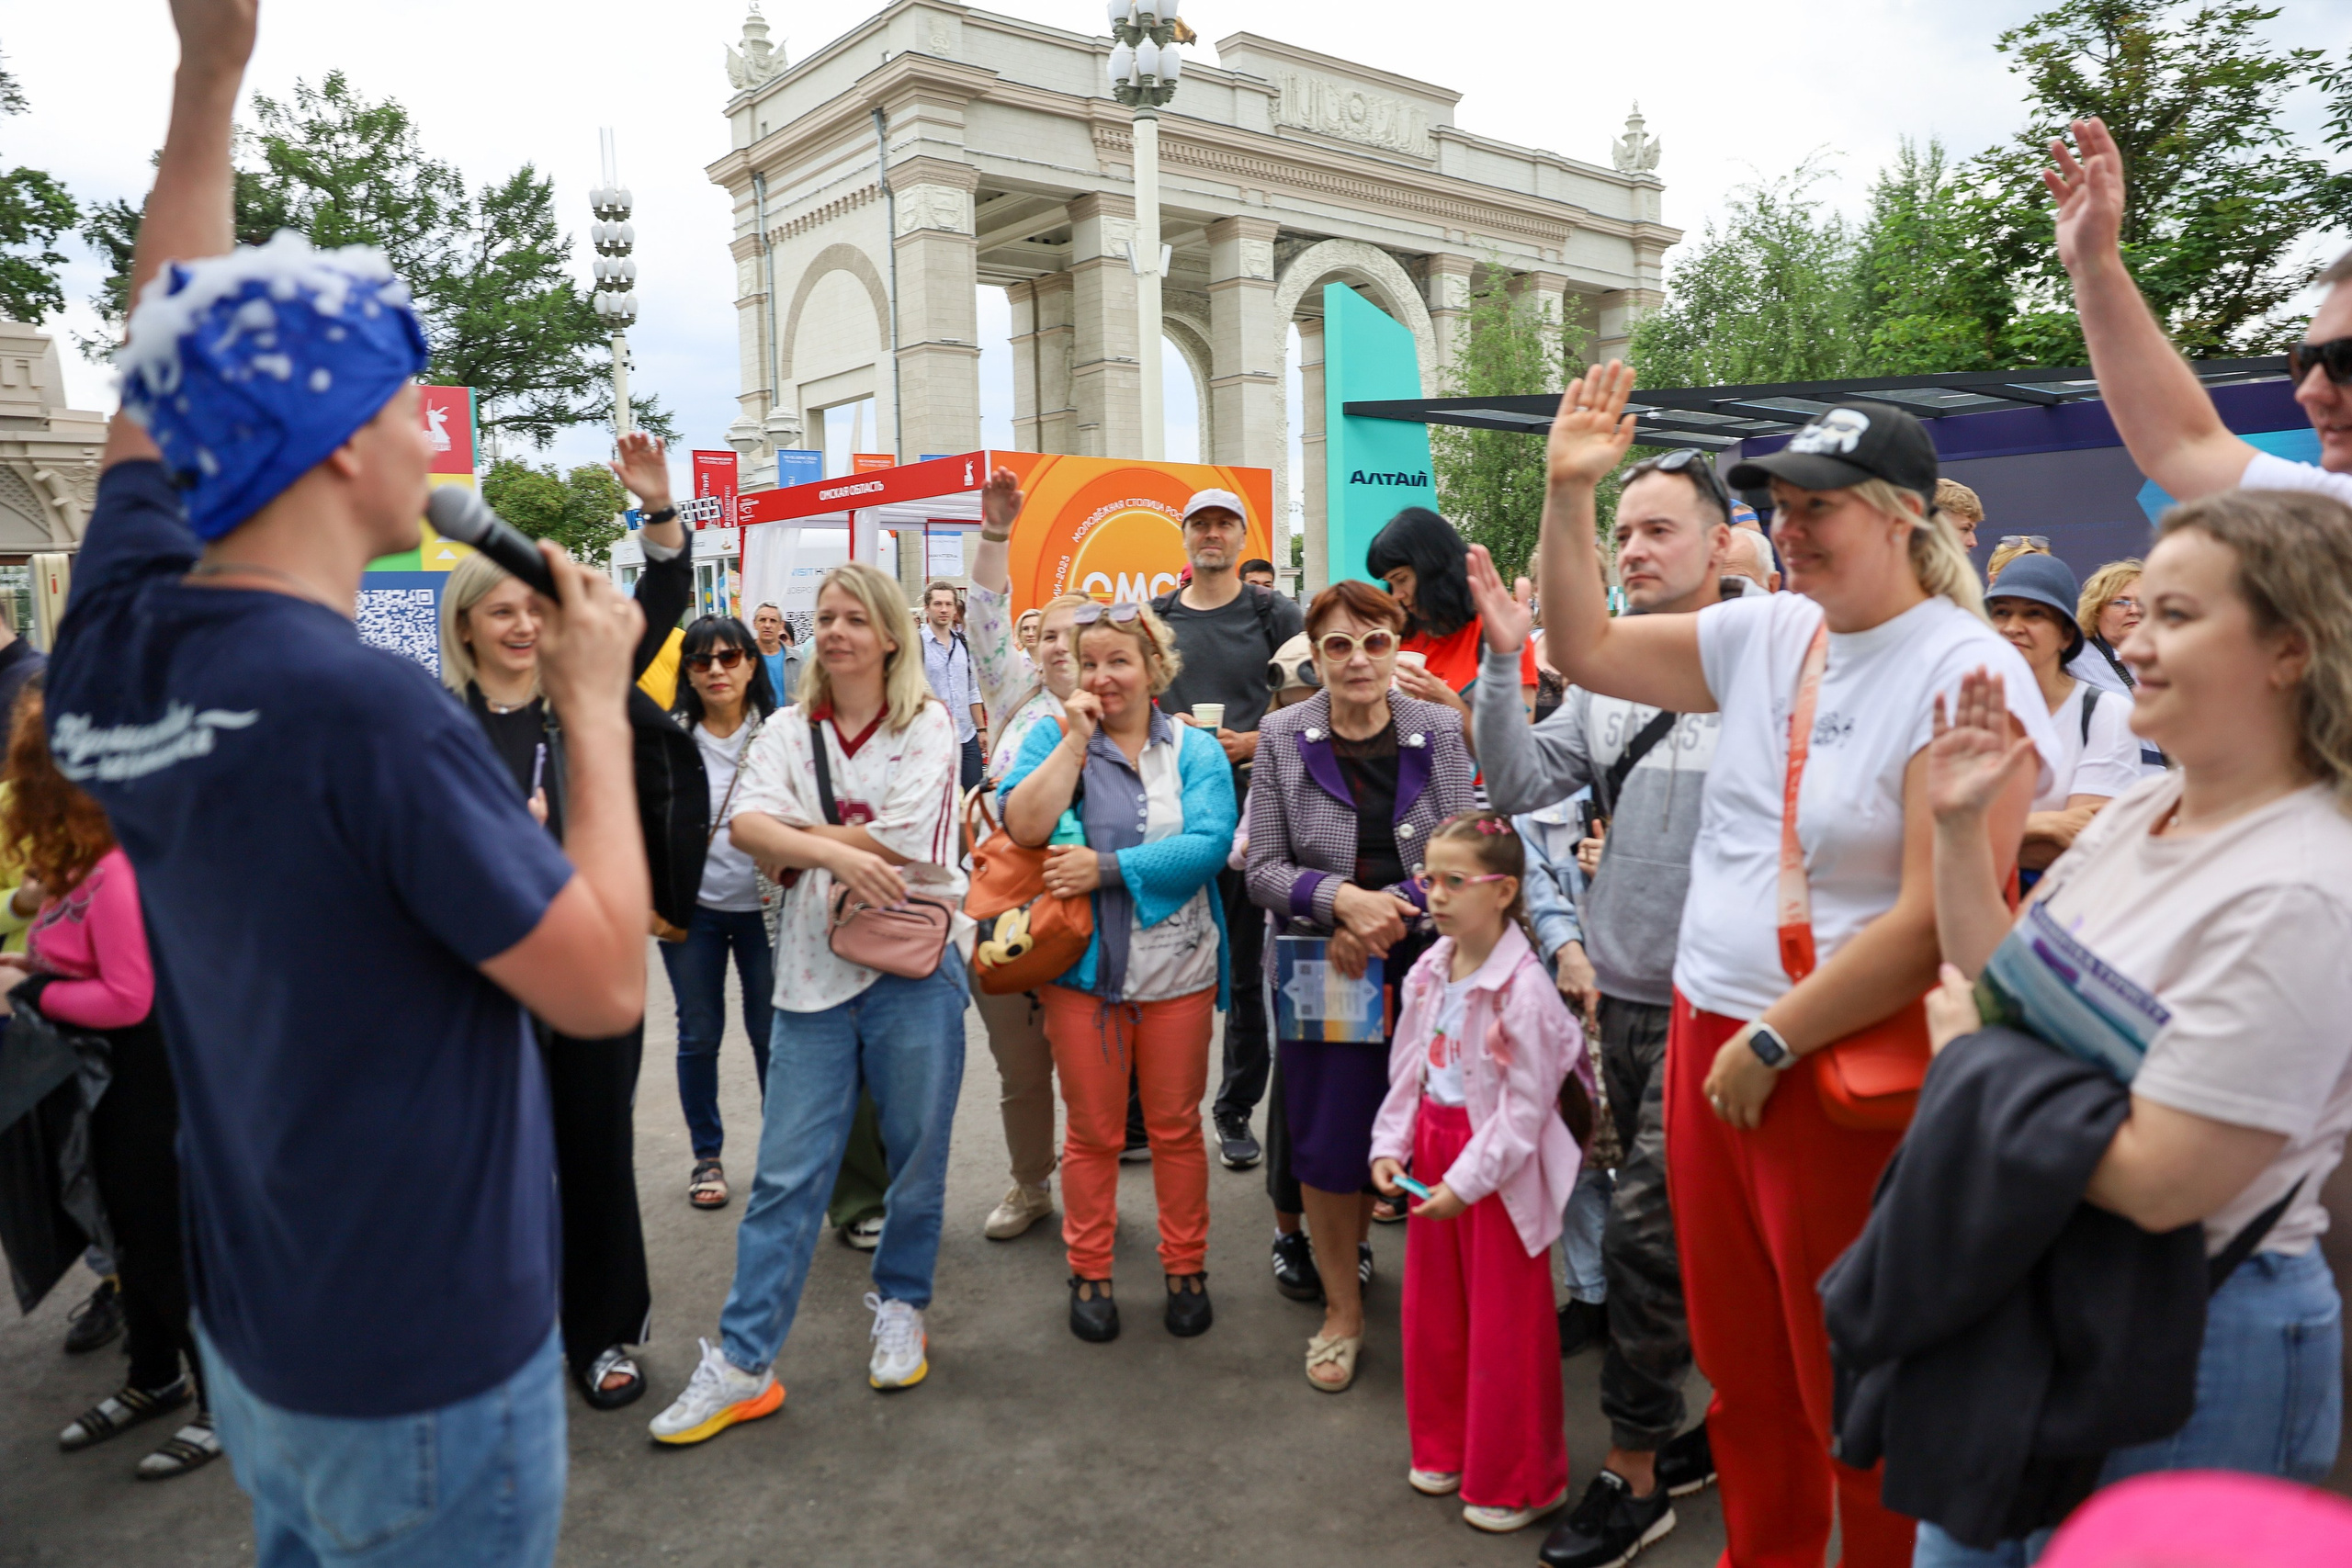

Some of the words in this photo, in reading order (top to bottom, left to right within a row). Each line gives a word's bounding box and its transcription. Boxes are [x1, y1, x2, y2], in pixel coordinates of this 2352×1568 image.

[1350, 469, 1428, 487] АЛТАЙ
[819, 486, 850, 501] ОМСКАЯ
[849, 480, 885, 496] ОБЛАСТЬ
[1053, 555, 1071, 599] ИИ-2025
[1071, 500, 1125, 543] МОЛОДЁЖНАЯ
[1125, 498, 1165, 512] СТОЛИЦА
[1165, 505, 1183, 522] РОС
